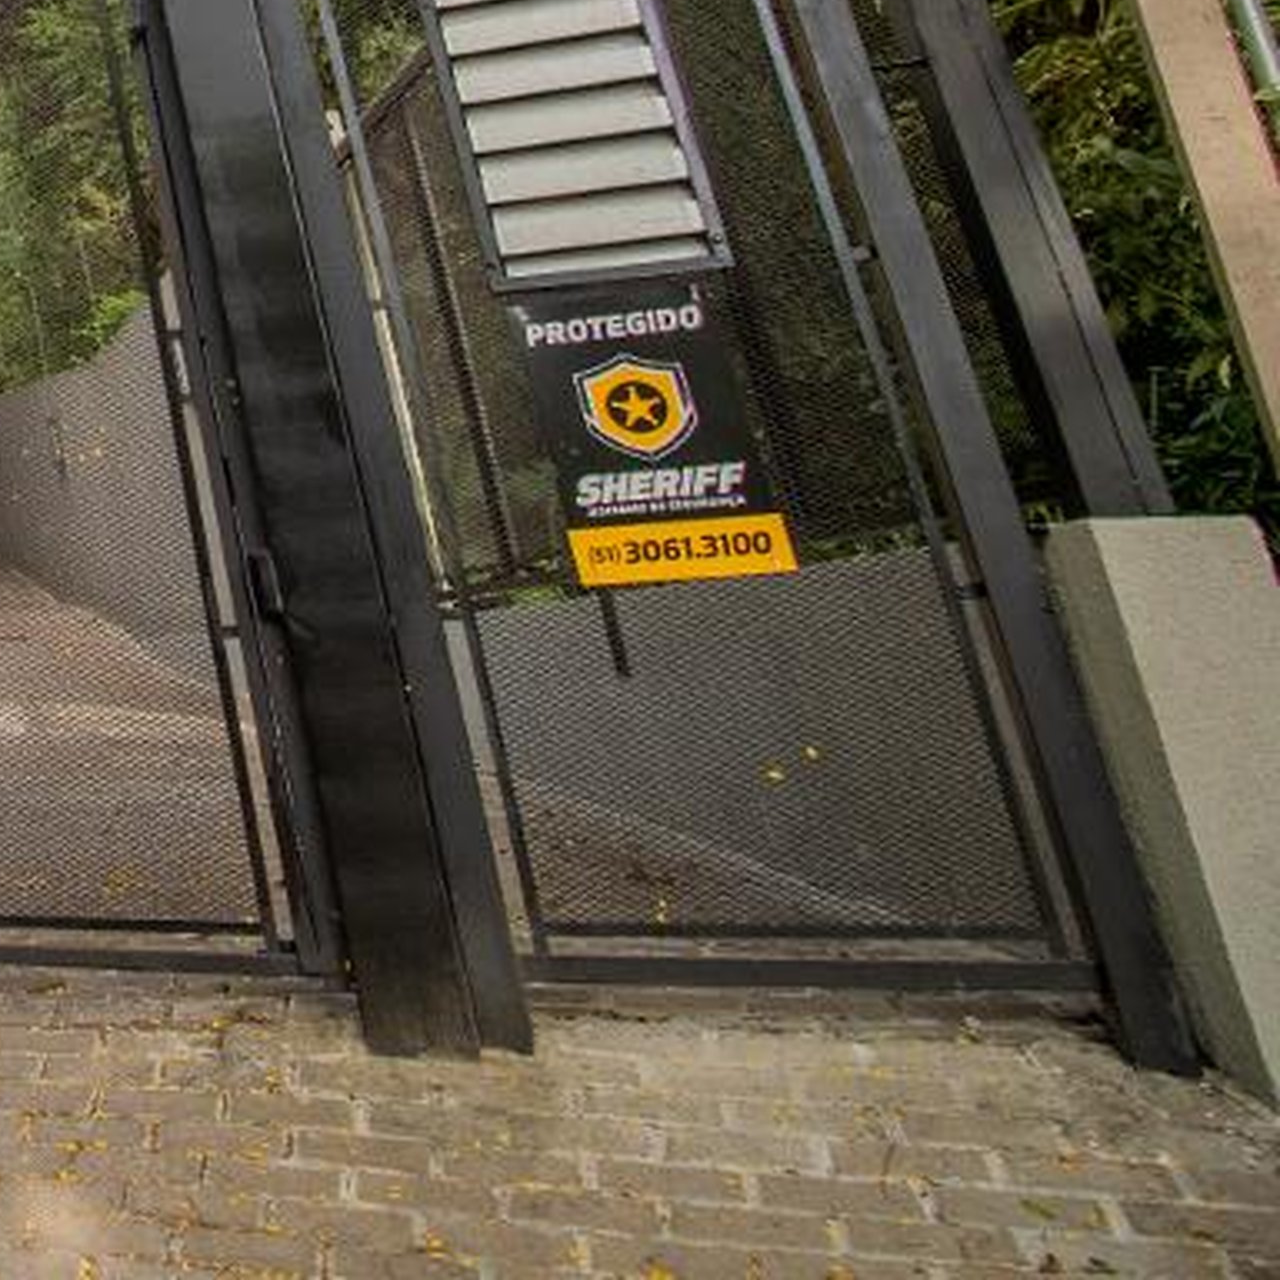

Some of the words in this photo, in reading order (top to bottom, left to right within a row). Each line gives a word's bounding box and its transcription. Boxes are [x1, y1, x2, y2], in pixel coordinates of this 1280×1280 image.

[526, 304, 701, 346] PROTEGIDO
[576, 461, 746, 507] SHERIFF
[625, 531, 772, 564] 3061.3100
